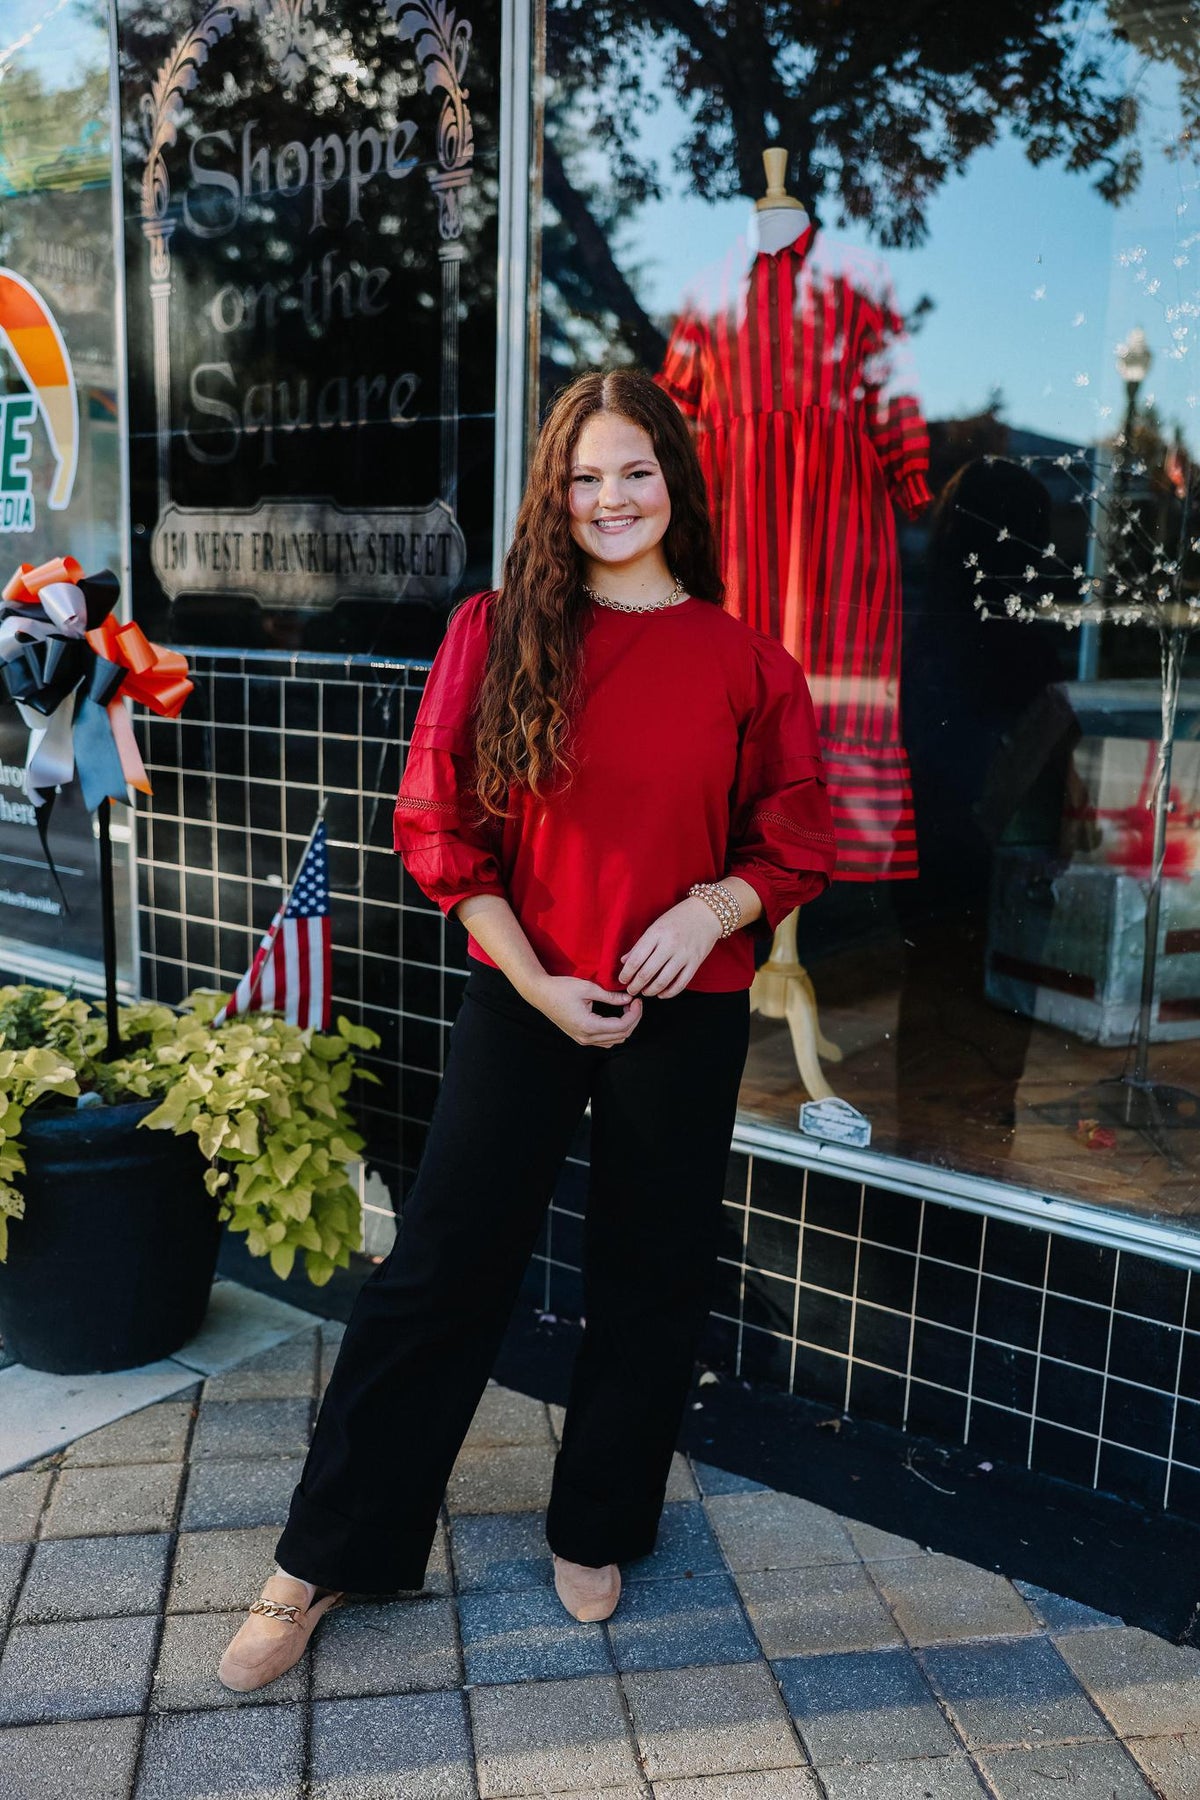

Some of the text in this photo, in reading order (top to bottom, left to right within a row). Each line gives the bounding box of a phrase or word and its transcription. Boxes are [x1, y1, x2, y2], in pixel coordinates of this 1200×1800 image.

[183, 119, 419, 239] Shoppe
[211, 248, 393, 334] on the
[184, 361, 422, 469] Square
[163, 532, 451, 577] 150 WEST FRANKLIN STREET
